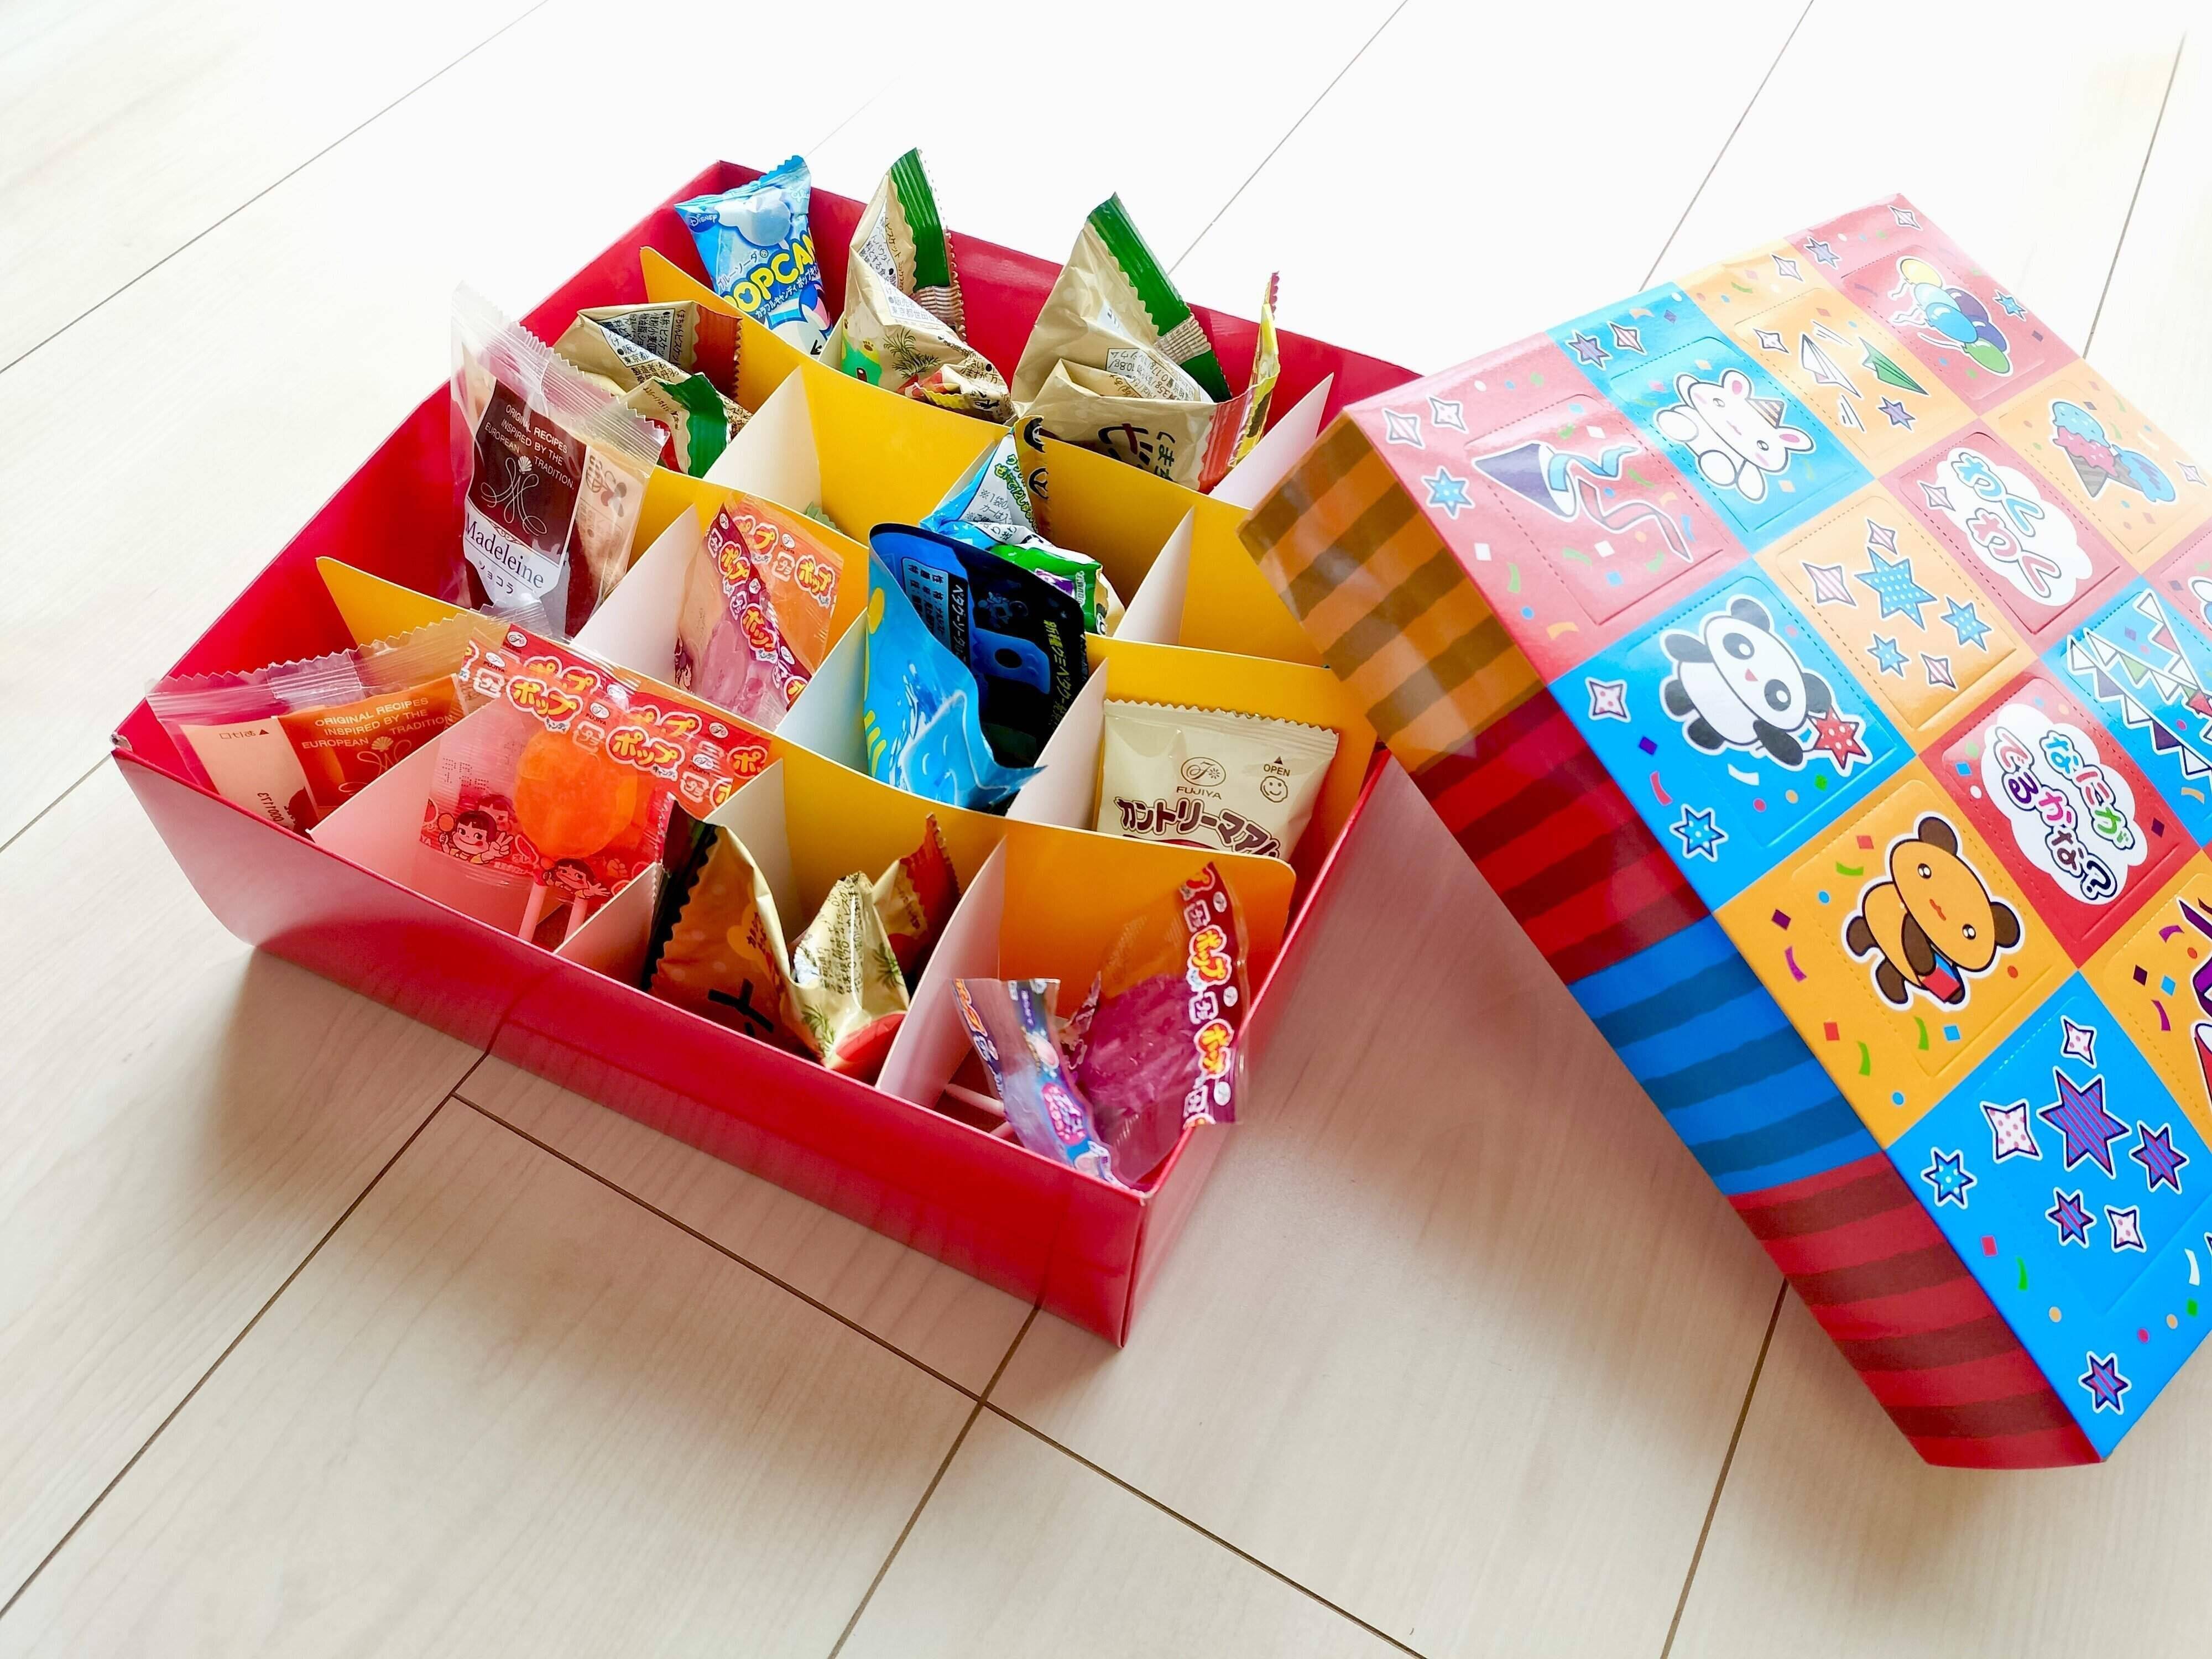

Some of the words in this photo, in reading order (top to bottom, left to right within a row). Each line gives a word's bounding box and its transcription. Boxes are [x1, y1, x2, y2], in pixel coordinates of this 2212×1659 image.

[500, 418, 533, 447] INSPIRED
[534, 441, 549, 455] BY
[548, 448, 564, 466] THE
[504, 404, 533, 433] ORIGINAL
[533, 426, 569, 454] RECIPES
[484, 421, 521, 455] EUROPEAN
[534, 455, 575, 491] TRADITION.
[1952, 452, 2044, 537] わく
[465, 519, 545, 589] Madeleine
[1966, 508, 2062, 598] わく
[477, 560, 515, 595] ショコラ
[799, 561, 832, 594] ポップ
[483, 660, 505, 674] FUJIYA
[314, 708, 375, 727] ORIGINAL
[376, 697, 429, 714] RECIPES
[513, 681, 578, 716] ポップ
[323, 720, 381, 736] INSPIRED
[383, 714, 401, 725] BY
[404, 708, 429, 719] THE
[585, 713, 607, 726] FUJIYA
[301, 736, 369, 749] EUROPEAN
[612, 731, 679, 766] ポップ
[1263, 763, 1291, 778] OPEN
[1176, 785, 1222, 801] FUJIYA
[2039, 730, 2135, 849] なにが
[1994, 726, 2117, 900] でるかな?
[1192, 929, 1227, 980] ポップ
